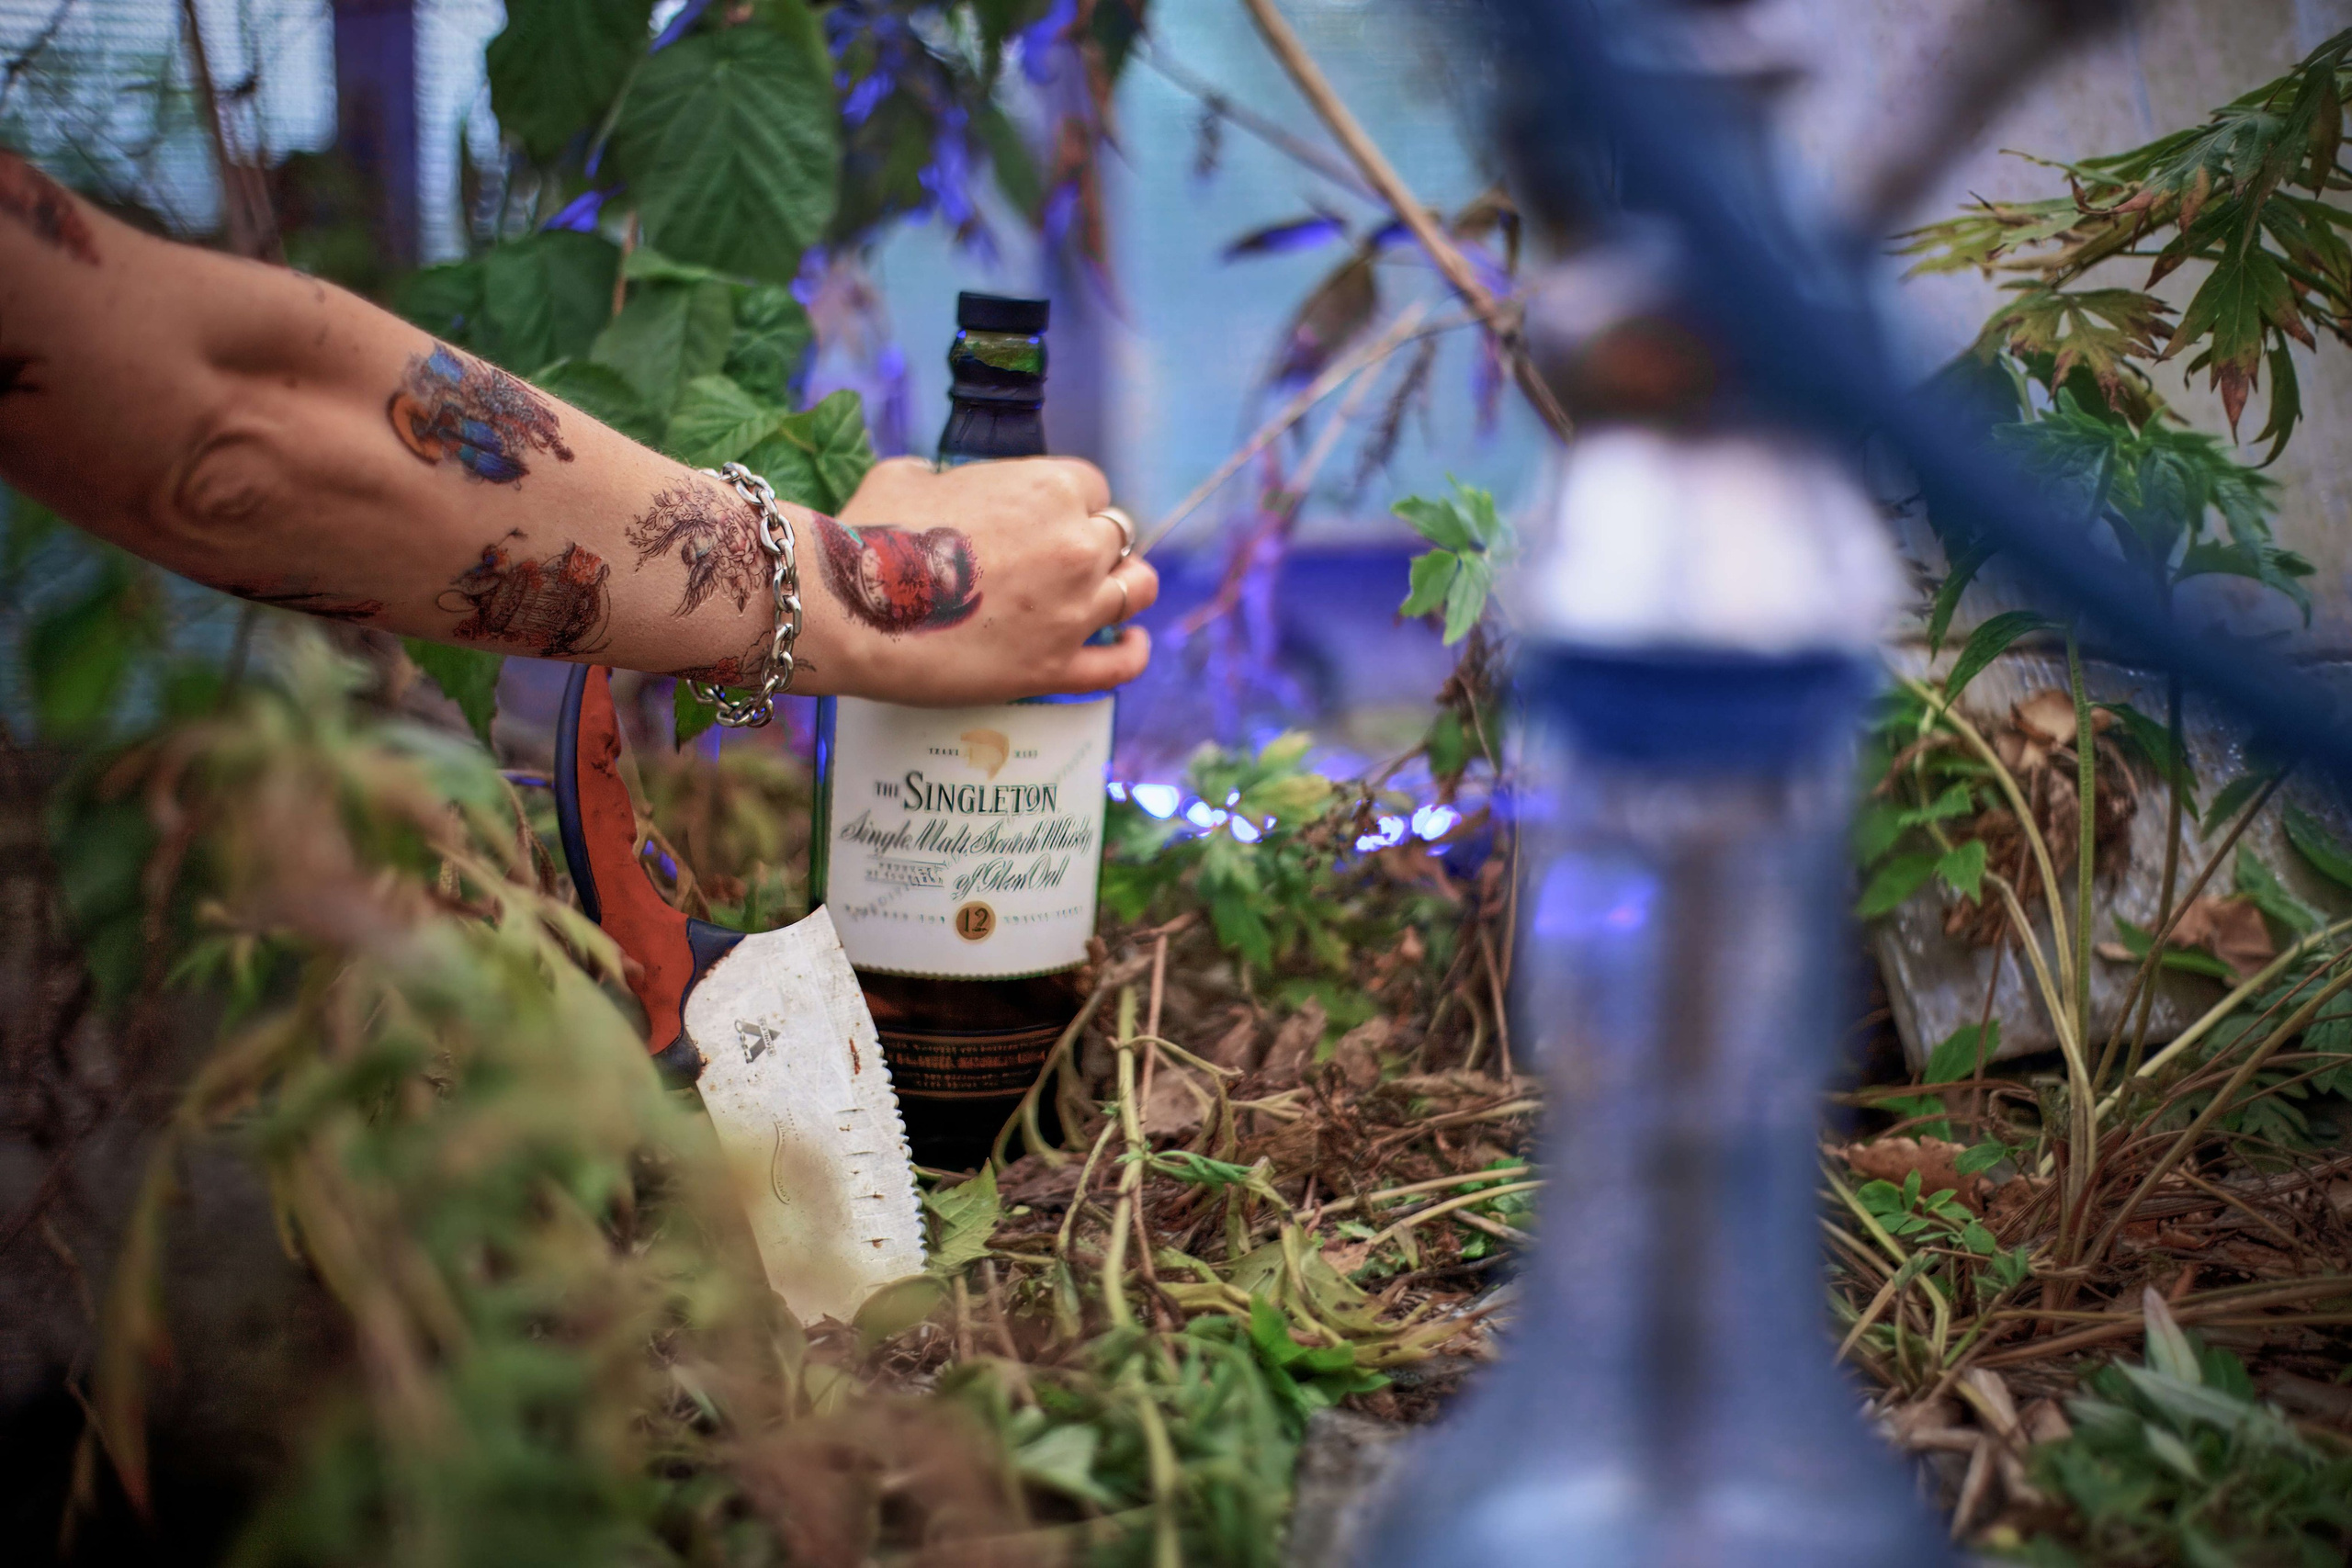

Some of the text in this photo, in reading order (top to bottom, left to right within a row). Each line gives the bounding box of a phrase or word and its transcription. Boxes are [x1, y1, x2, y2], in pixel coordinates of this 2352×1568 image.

[903, 771, 1057, 814] SINGLETON
[840, 809, 912, 854] Single
[915, 818, 971, 854] Malt
[964, 908, 989, 932] 12
